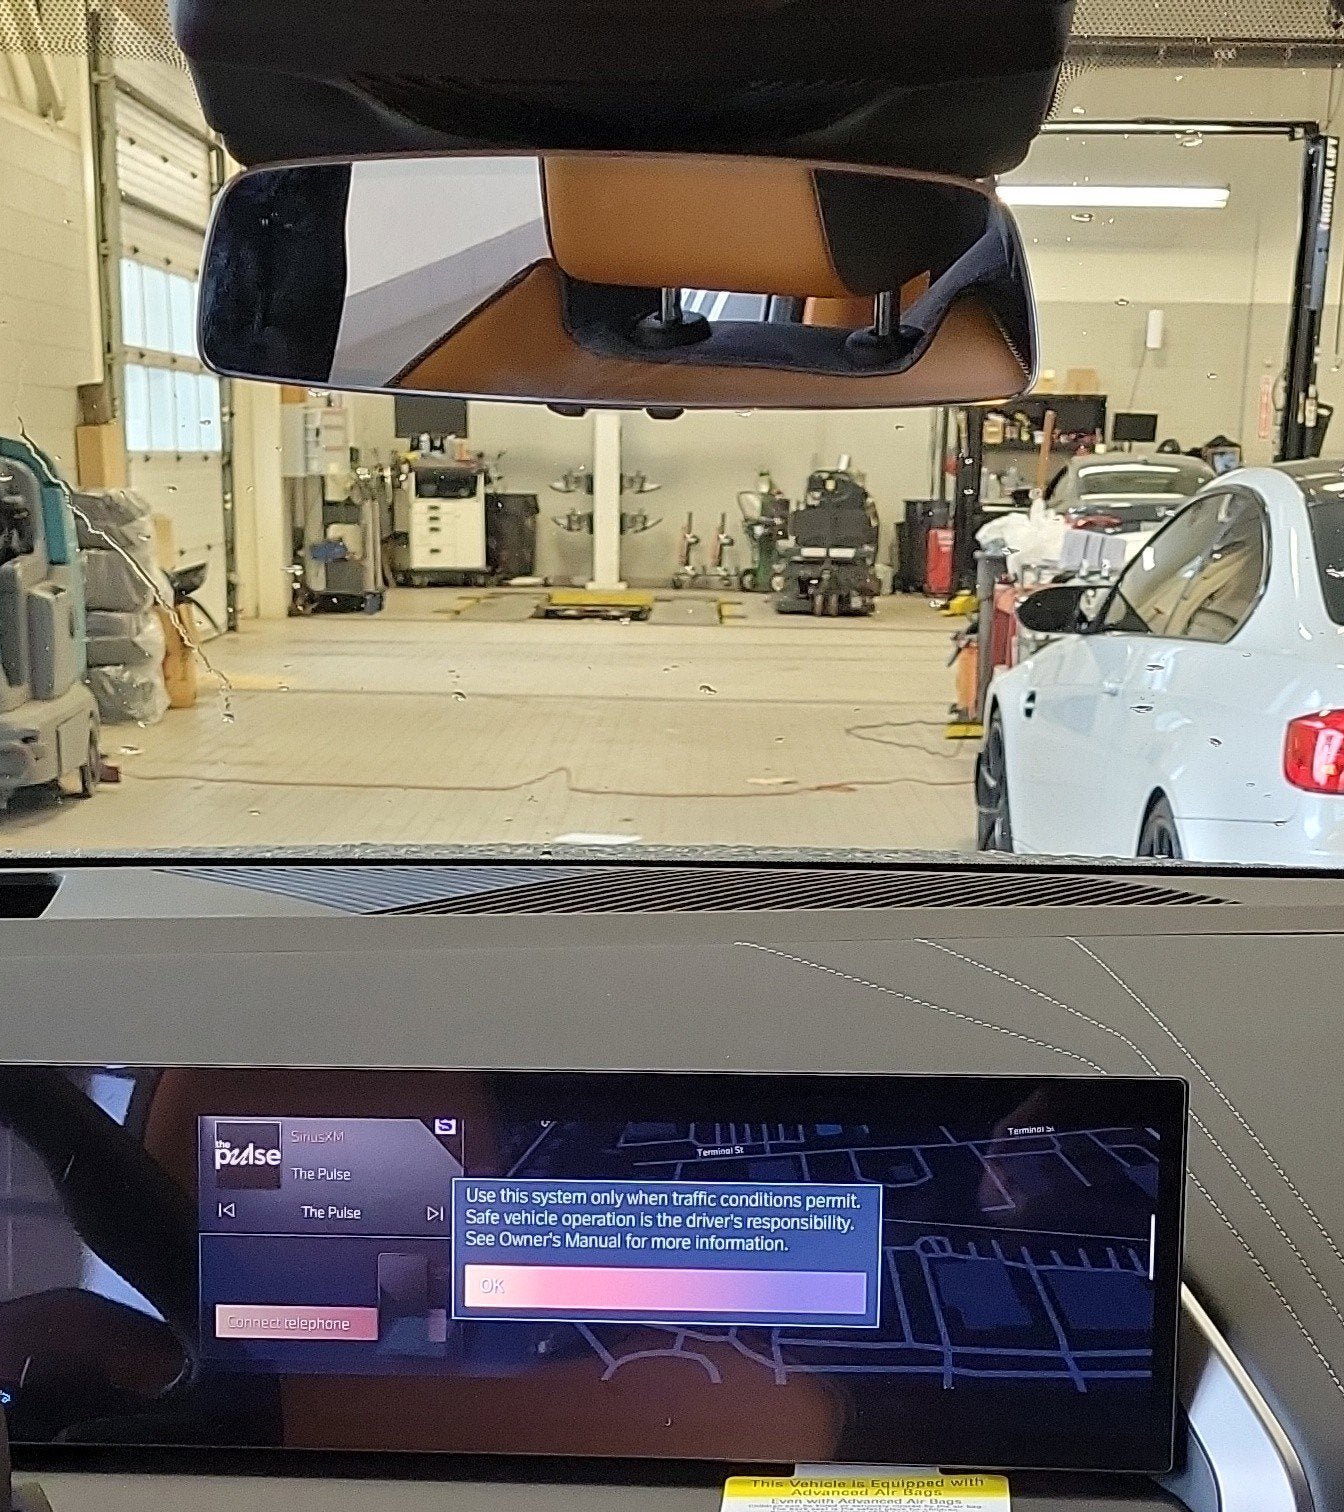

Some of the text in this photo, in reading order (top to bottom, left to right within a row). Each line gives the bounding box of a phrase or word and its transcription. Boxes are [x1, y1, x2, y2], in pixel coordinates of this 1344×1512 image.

[1325, 136, 1339, 168] LIFT
[215, 1140, 231, 1149] the
[291, 1130, 345, 1144] SiriusXM
[215, 1142, 282, 1169] pulse
[696, 1146, 734, 1157] Terminal
[291, 1167, 352, 1181] The Pulse
[466, 1187, 861, 1211] Use this system only when traffic conditions permit.
[301, 1205, 362, 1220] The Pulse
[465, 1208, 855, 1234] Safe vehicle operation is the driver's responsibility.
[465, 1231, 789, 1251] See Owner's Manual for more information.
[480, 1278, 505, 1294] OK
[227, 1315, 351, 1332] Connect telephone
[751, 1478, 784, 1488] This
[787, 1478, 847, 1488] Vehicle
[870, 1478, 944, 1490] Equipped
[950, 1477, 985, 1487] with
[791, 1488, 943, 1498] Advanced Air Bags
[771, 1497, 803, 1505] Even
[838, 1498, 903, 1506] Advanced
[907, 1498, 927, 1506] Air
[930, 1498, 963, 1507] Bags
